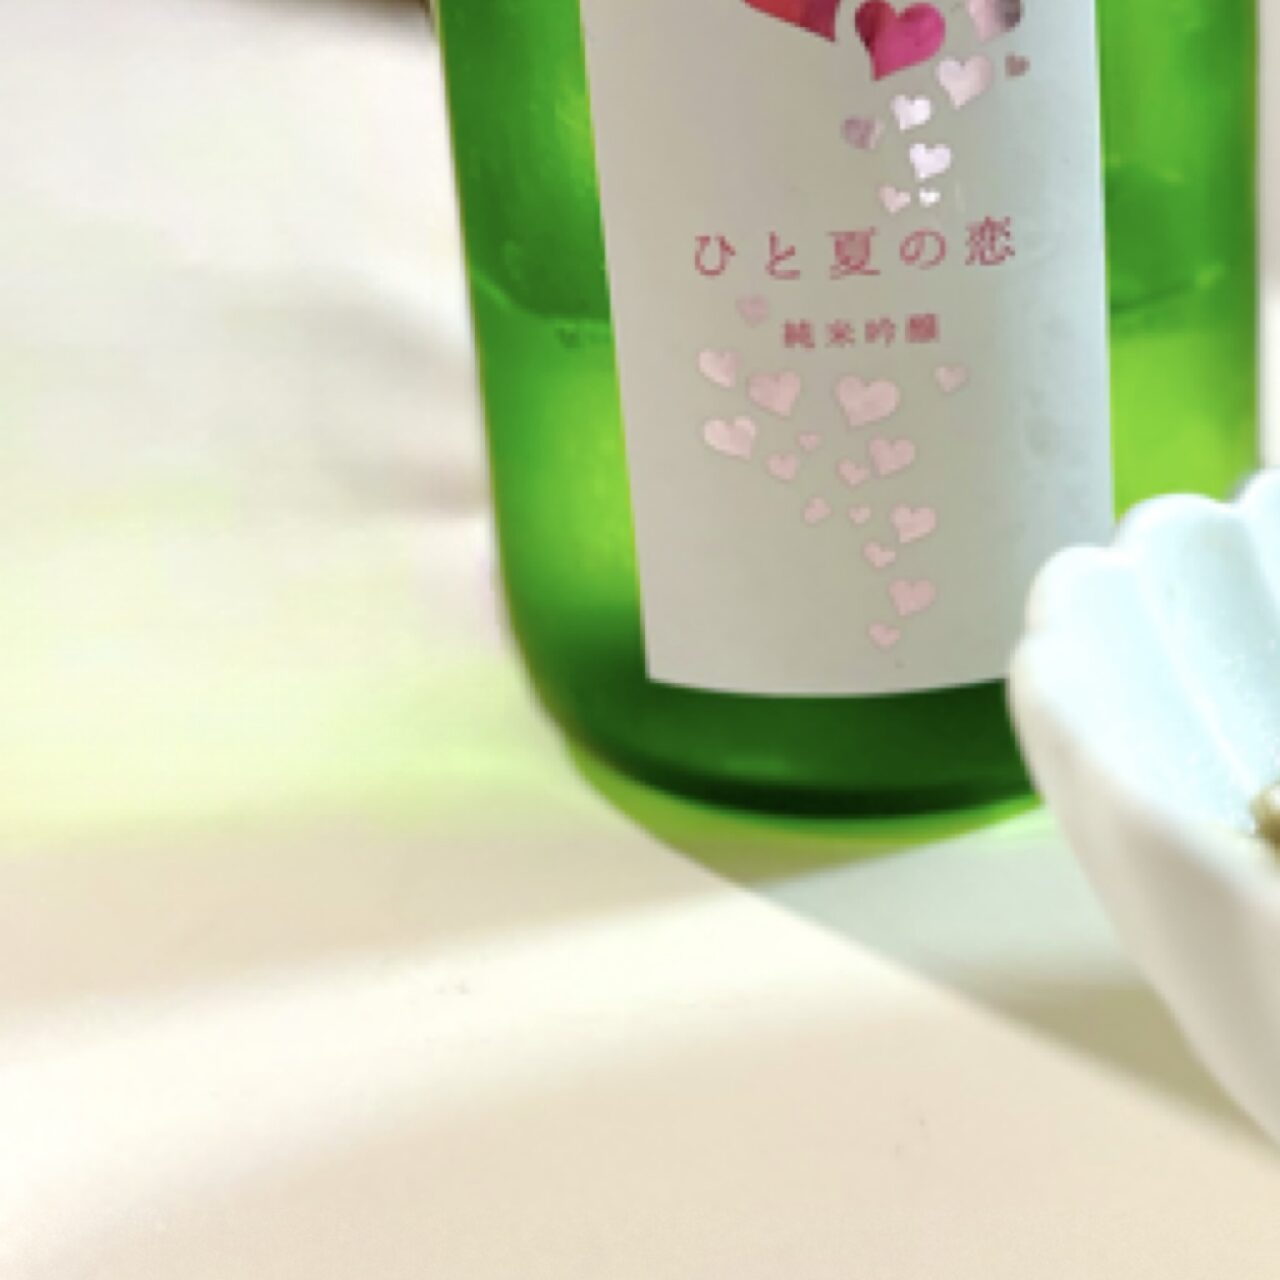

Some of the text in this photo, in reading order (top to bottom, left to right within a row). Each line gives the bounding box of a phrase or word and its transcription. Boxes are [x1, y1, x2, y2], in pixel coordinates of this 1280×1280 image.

[694, 216, 1016, 280] ひと夏の恋
[782, 313, 940, 348] 純米吟醸
